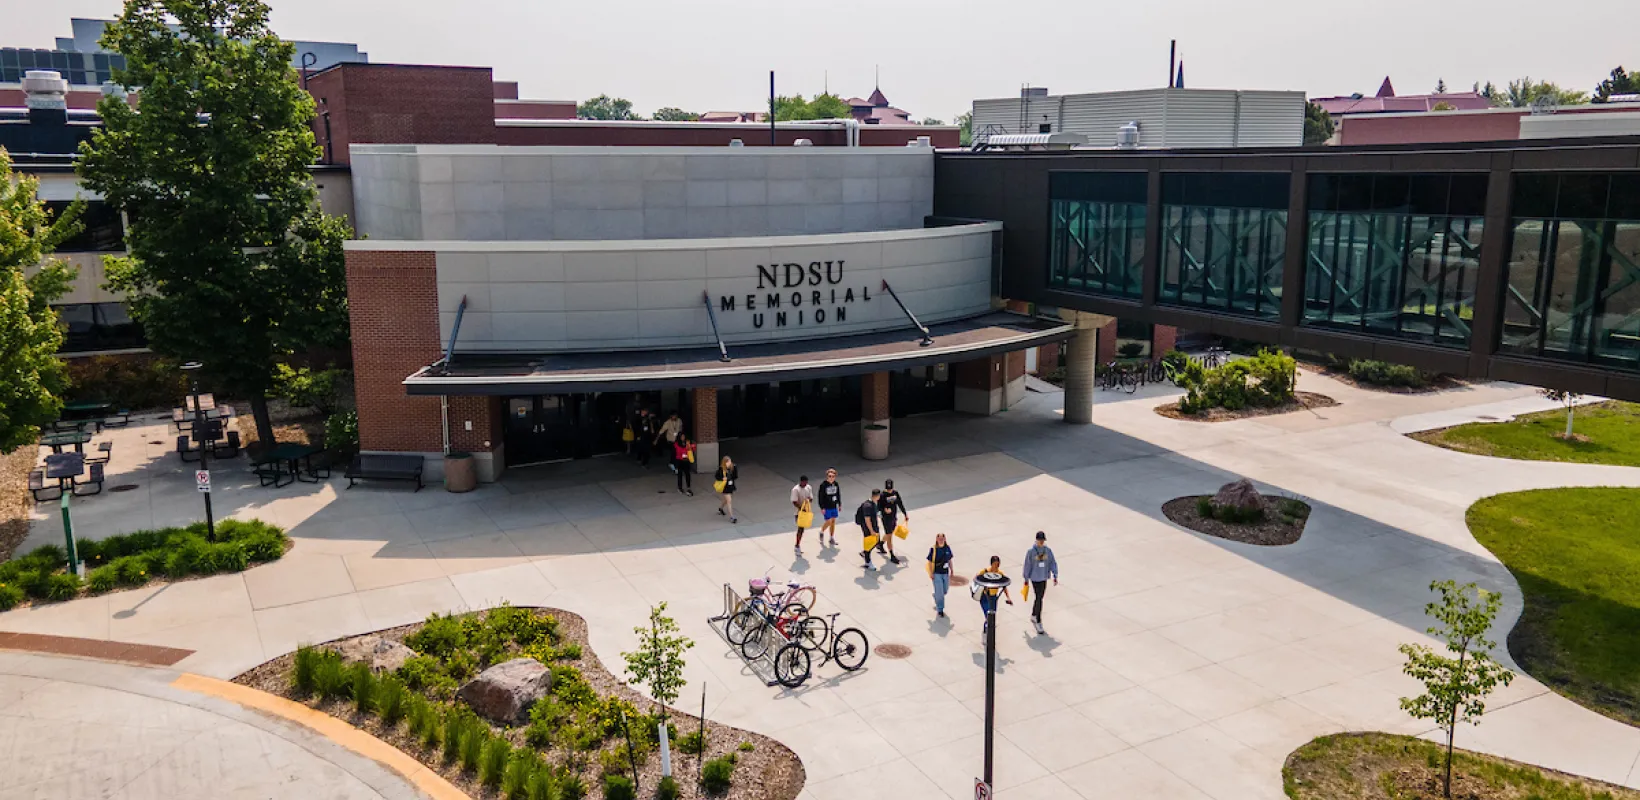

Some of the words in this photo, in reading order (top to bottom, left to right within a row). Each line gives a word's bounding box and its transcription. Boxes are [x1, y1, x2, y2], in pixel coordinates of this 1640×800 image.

[757, 260, 845, 289] NDSU
[721, 286, 871, 311] MEMORIAL
[753, 307, 846, 328] UNION
